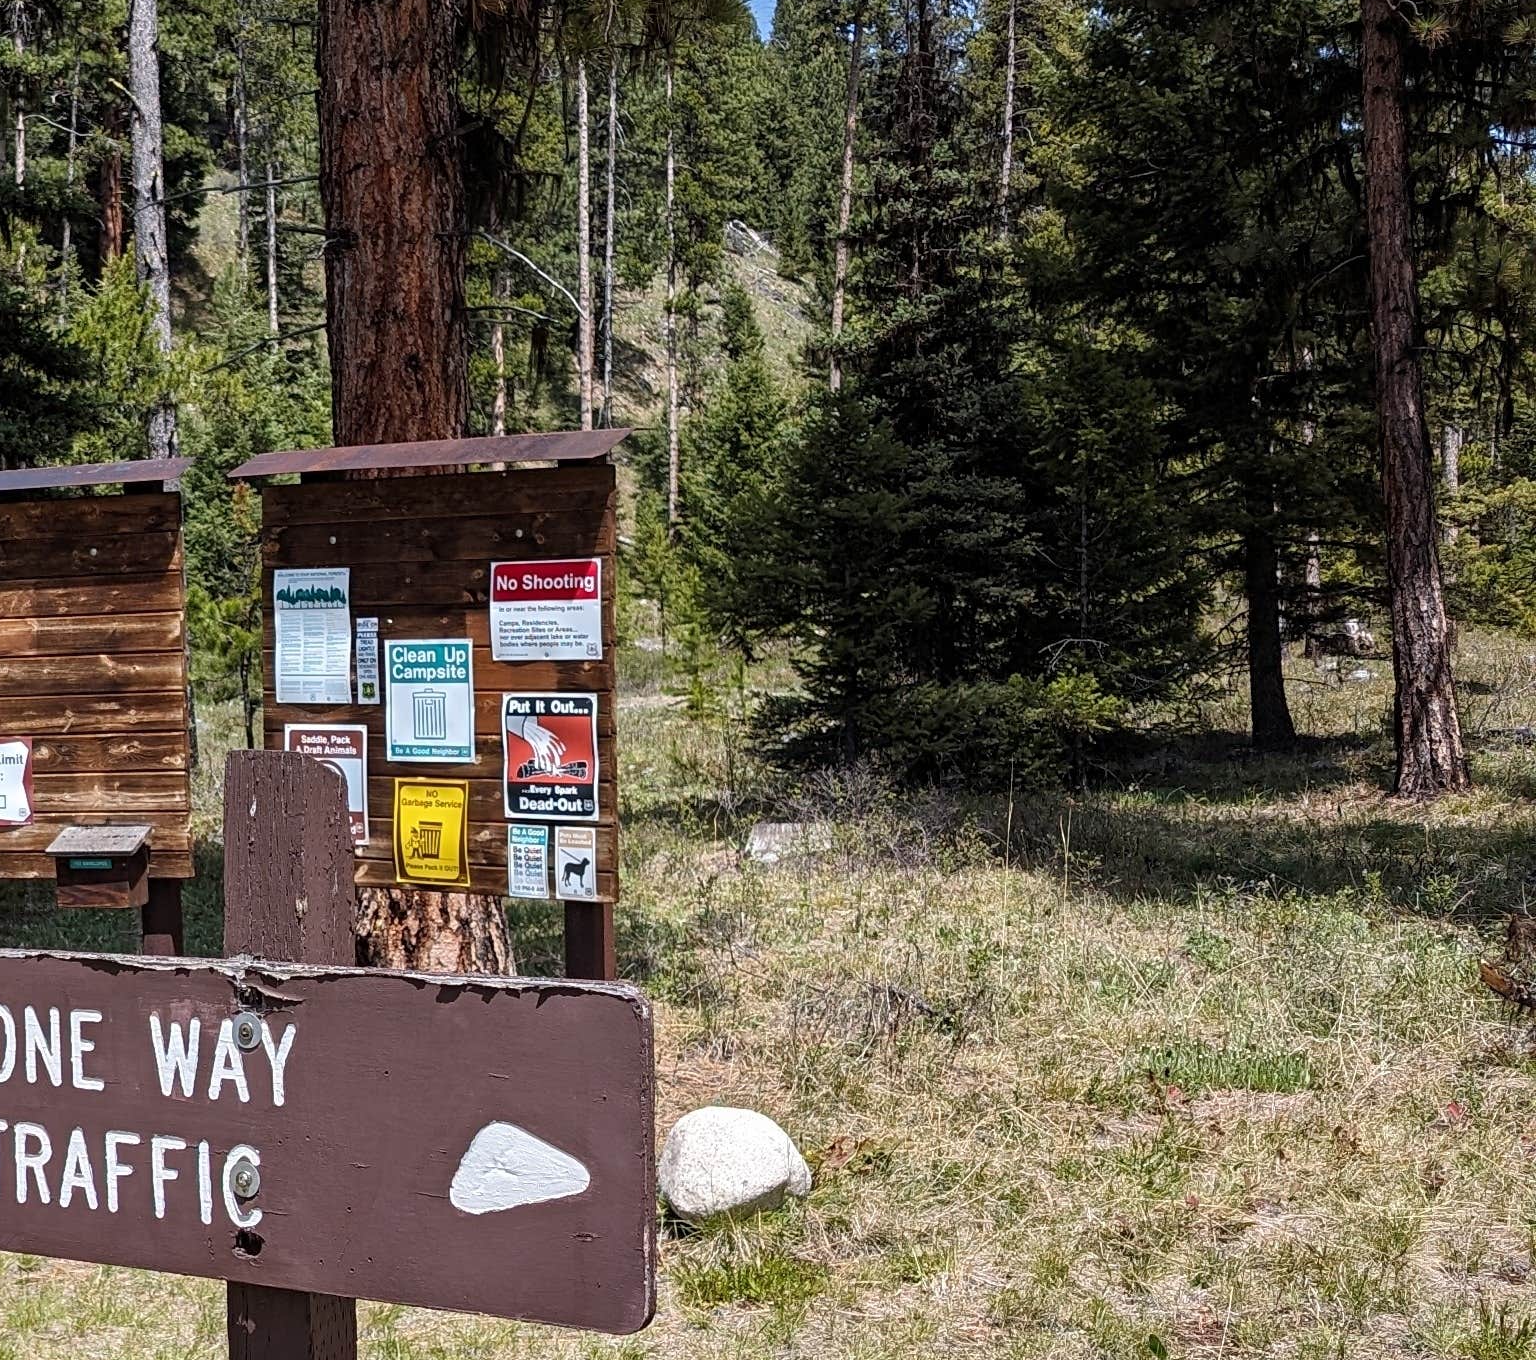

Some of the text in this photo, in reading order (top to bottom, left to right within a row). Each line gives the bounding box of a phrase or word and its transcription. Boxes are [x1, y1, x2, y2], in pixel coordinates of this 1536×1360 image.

[496, 573, 594, 592] No Shooting
[538, 605, 565, 613] following
[392, 647, 466, 665] Clean Up
[392, 664, 466, 681] Campsite
[509, 700, 589, 714] Put It Out...
[301, 735, 351, 745] Saddle, Pack
[304, 746, 323, 754] Draft
[324, 746, 357, 755] Animals
[432, 748, 459, 756] Neighbor
[426, 790, 438, 798] NO
[555, 785, 578, 795] Spark
[401, 798, 462, 808] Garbage Service
[519, 797, 583, 811] Dead-Out
[149, 1011, 297, 1107] WAY
